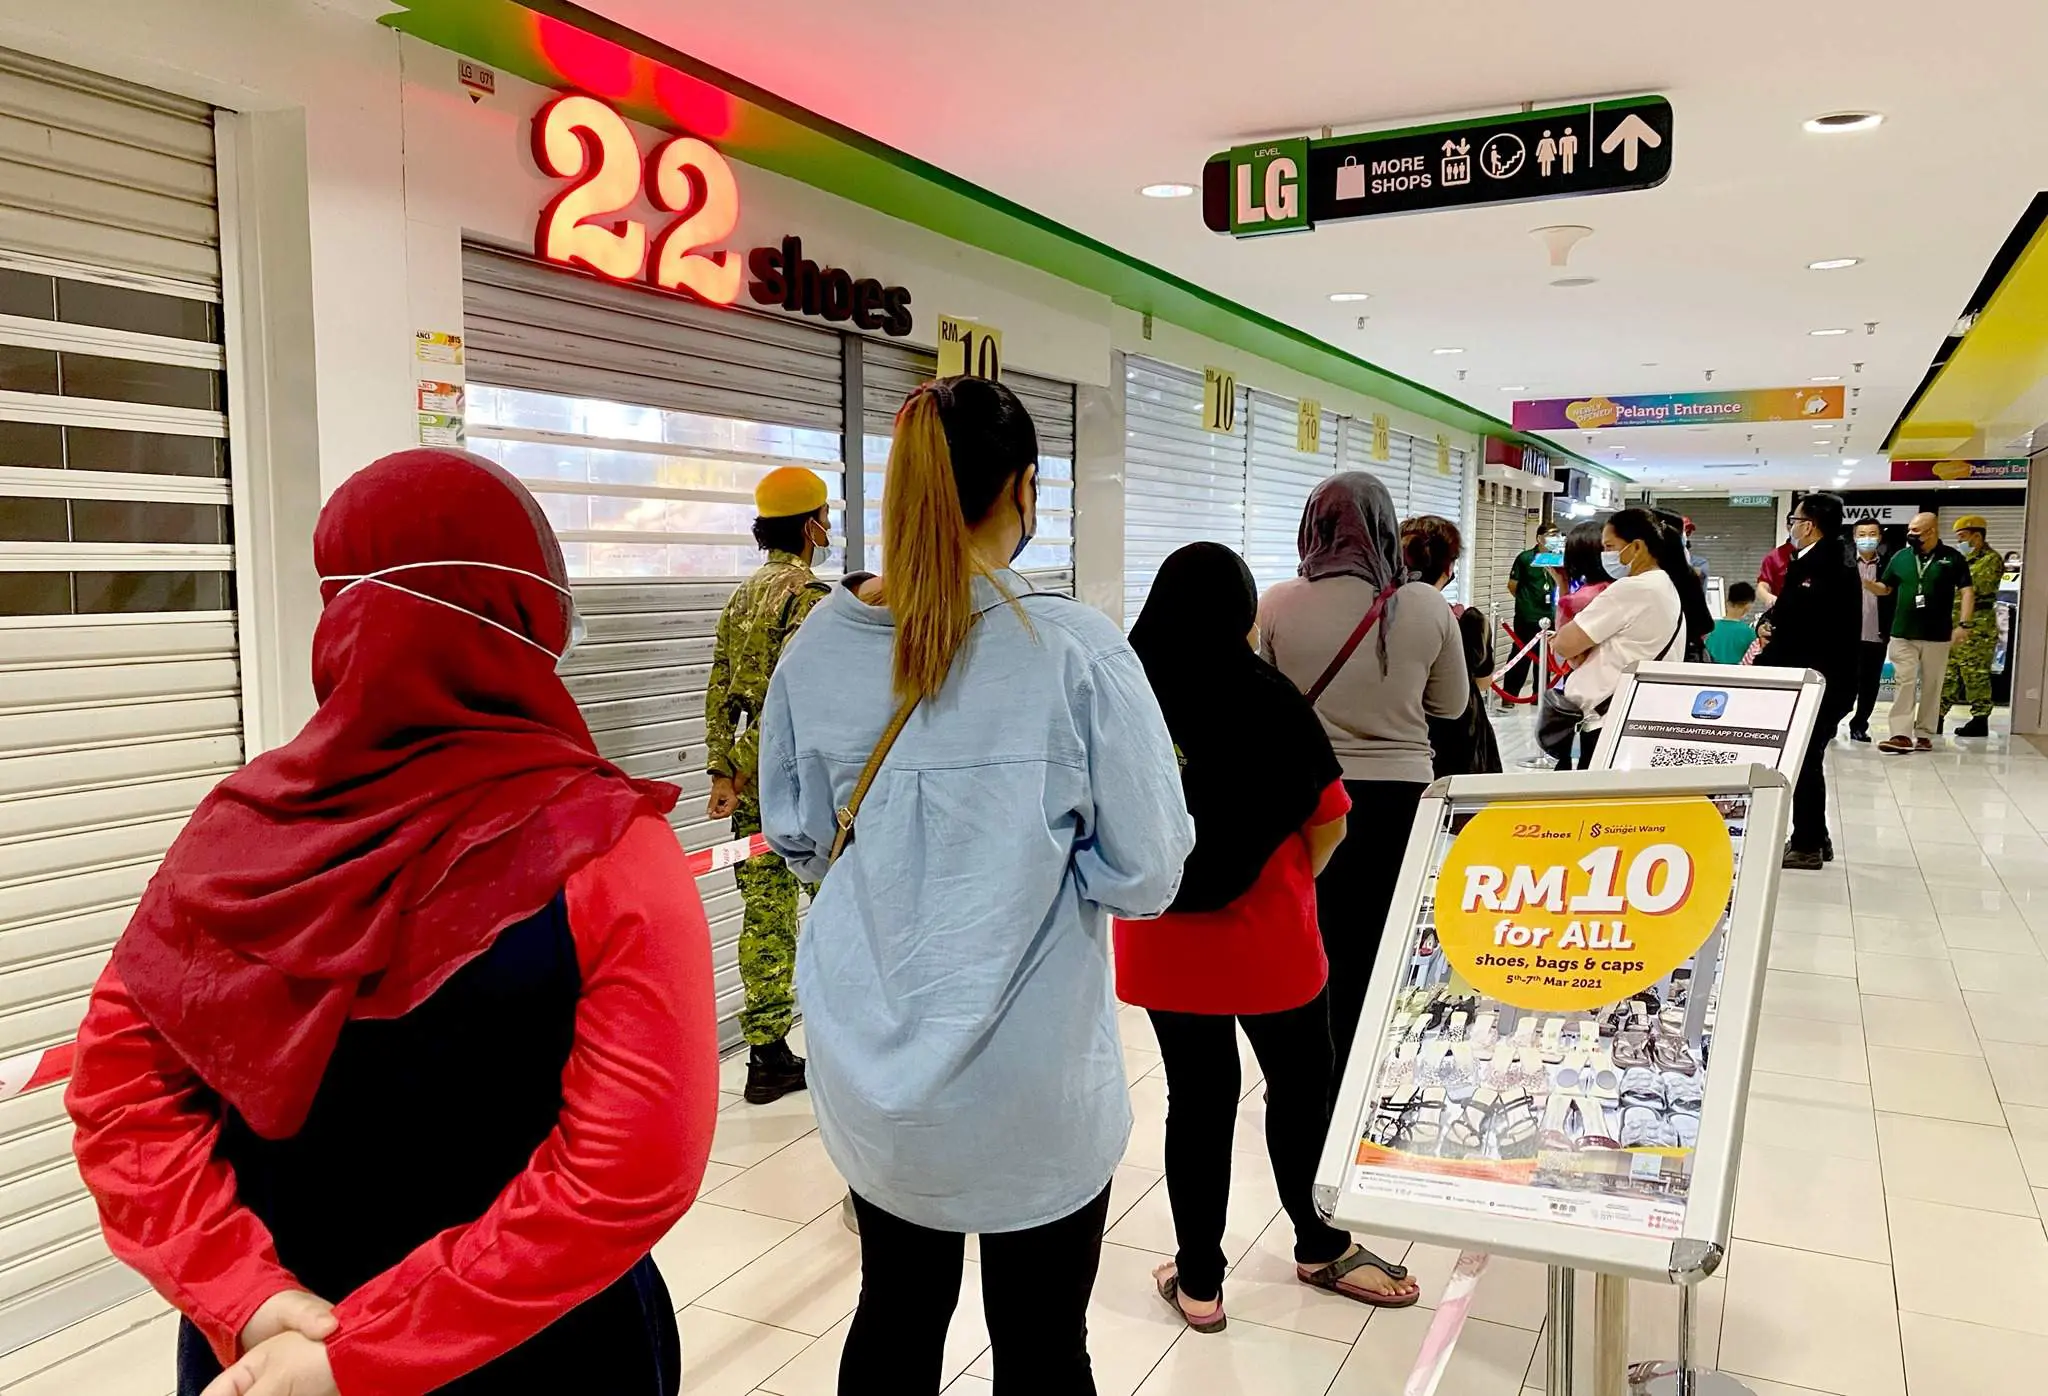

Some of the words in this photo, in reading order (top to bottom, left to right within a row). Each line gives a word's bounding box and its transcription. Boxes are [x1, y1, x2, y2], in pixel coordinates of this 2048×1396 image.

[461, 63, 472, 79] LG
[480, 71, 493, 87] 071
[1254, 147, 1281, 158] LEVEL
[1371, 155, 1425, 175] MORE
[1236, 157, 1299, 225] LG
[1371, 173, 1432, 195] SHOPS
[532, 94, 743, 306] 22
[748, 234, 914, 337] shoes
[941, 319, 959, 344] RM
[1213, 374, 1235, 432] 10
[1615, 403, 1669, 419] Pelangi
[1674, 402, 1742, 416] Entrance
[1306, 418, 1317, 441] 10
[1969, 465, 2009, 475] Pelangi
[1842, 507, 1892, 519] WAVE
[1628, 723, 1648, 731] SCAN
[1648, 725, 1666, 733] WITH
[1665, 726, 1716, 736] MYSEJAHTERA
[1743, 732, 1780, 741] CHECK-IN
[1541, 830, 1571, 839] shoes
[1639, 824, 1665, 833] Wang
[1493, 919, 1554, 949] for
[1558, 920, 1635, 951] ALL
[1475, 953, 1530, 969] shoes,
[1536, 955, 1579, 973] bags
[1584, 957, 1596, 970] &
[1601, 960, 1644, 974] caps
[1544, 976, 1569, 987] Mar
[1571, 978, 1602, 989] 2021
